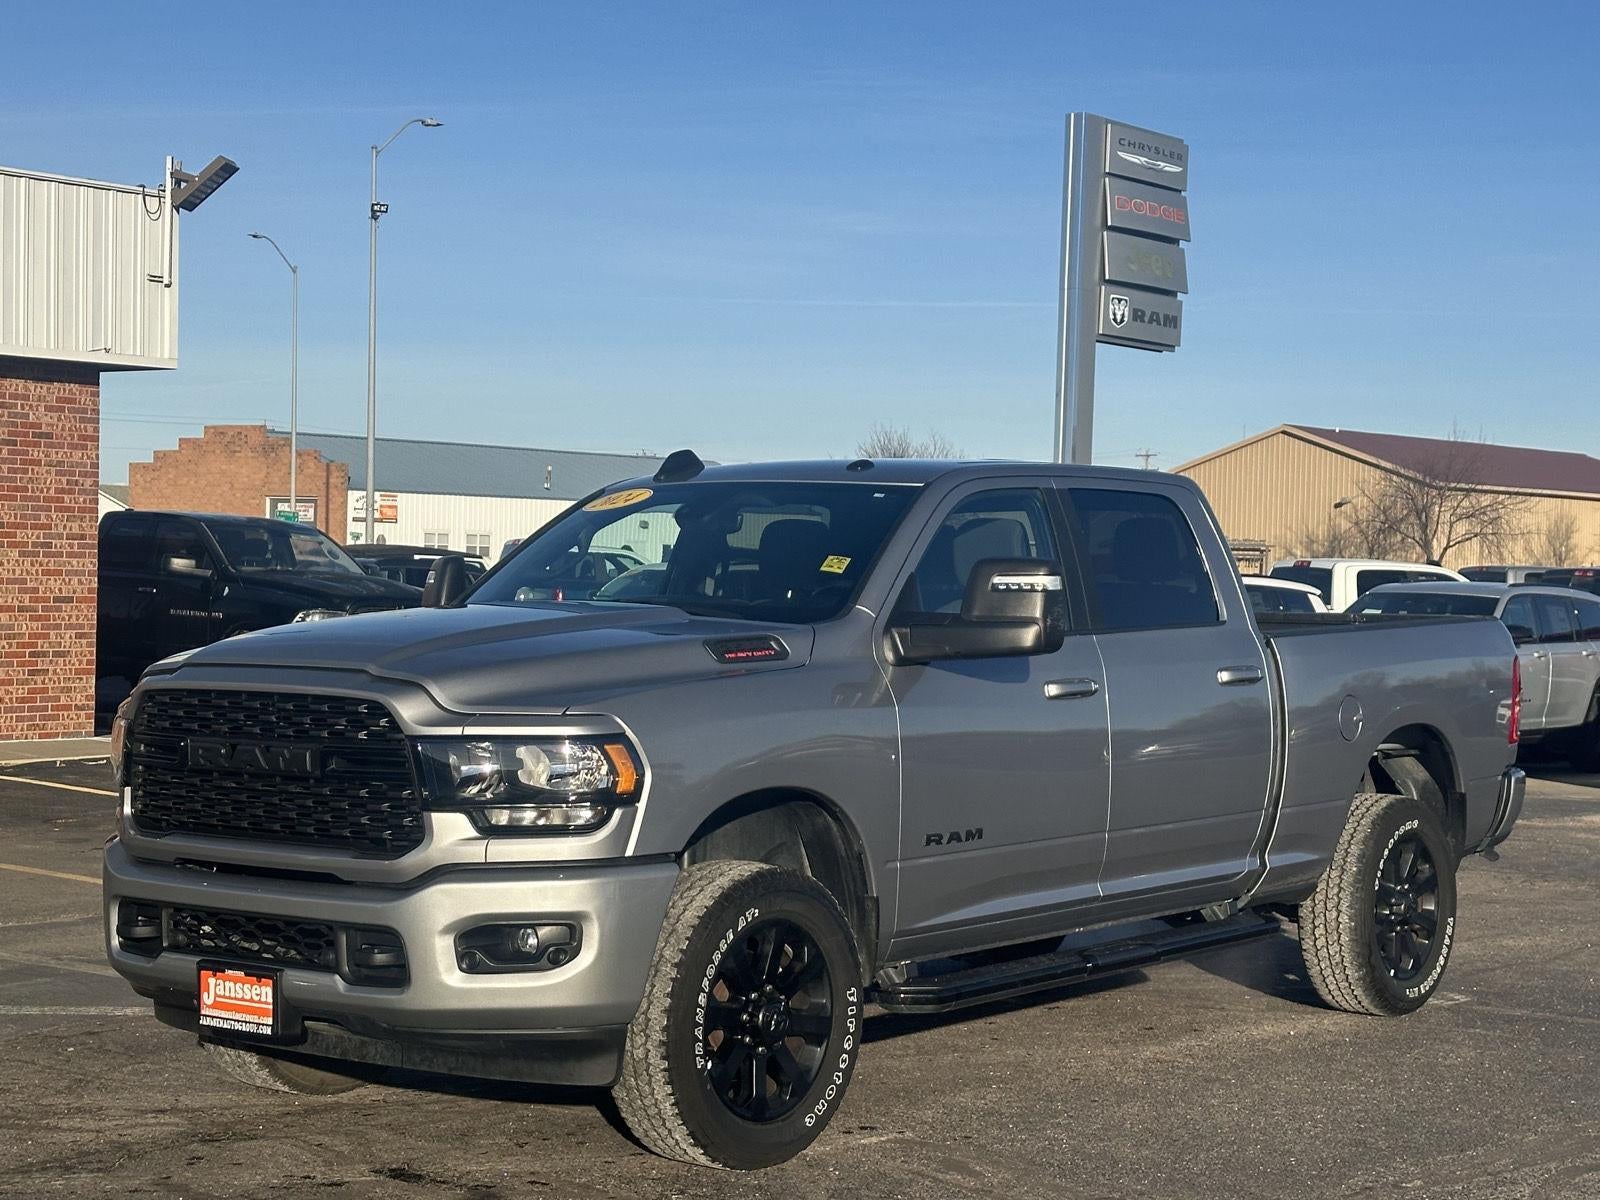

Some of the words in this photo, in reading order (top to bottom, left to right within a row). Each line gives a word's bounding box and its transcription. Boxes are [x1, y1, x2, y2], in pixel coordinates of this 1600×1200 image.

[1118, 138, 1184, 161] CHRYSLER
[1115, 195, 1185, 224] DODGE
[1131, 307, 1178, 329] RAM
[753, 649, 775, 657] DUTY
[189, 741, 312, 772] RAM
[925, 827, 983, 847] RAM
[203, 977, 273, 1006] Janssen
[695, 928, 735, 1070] TRANSFORCE
